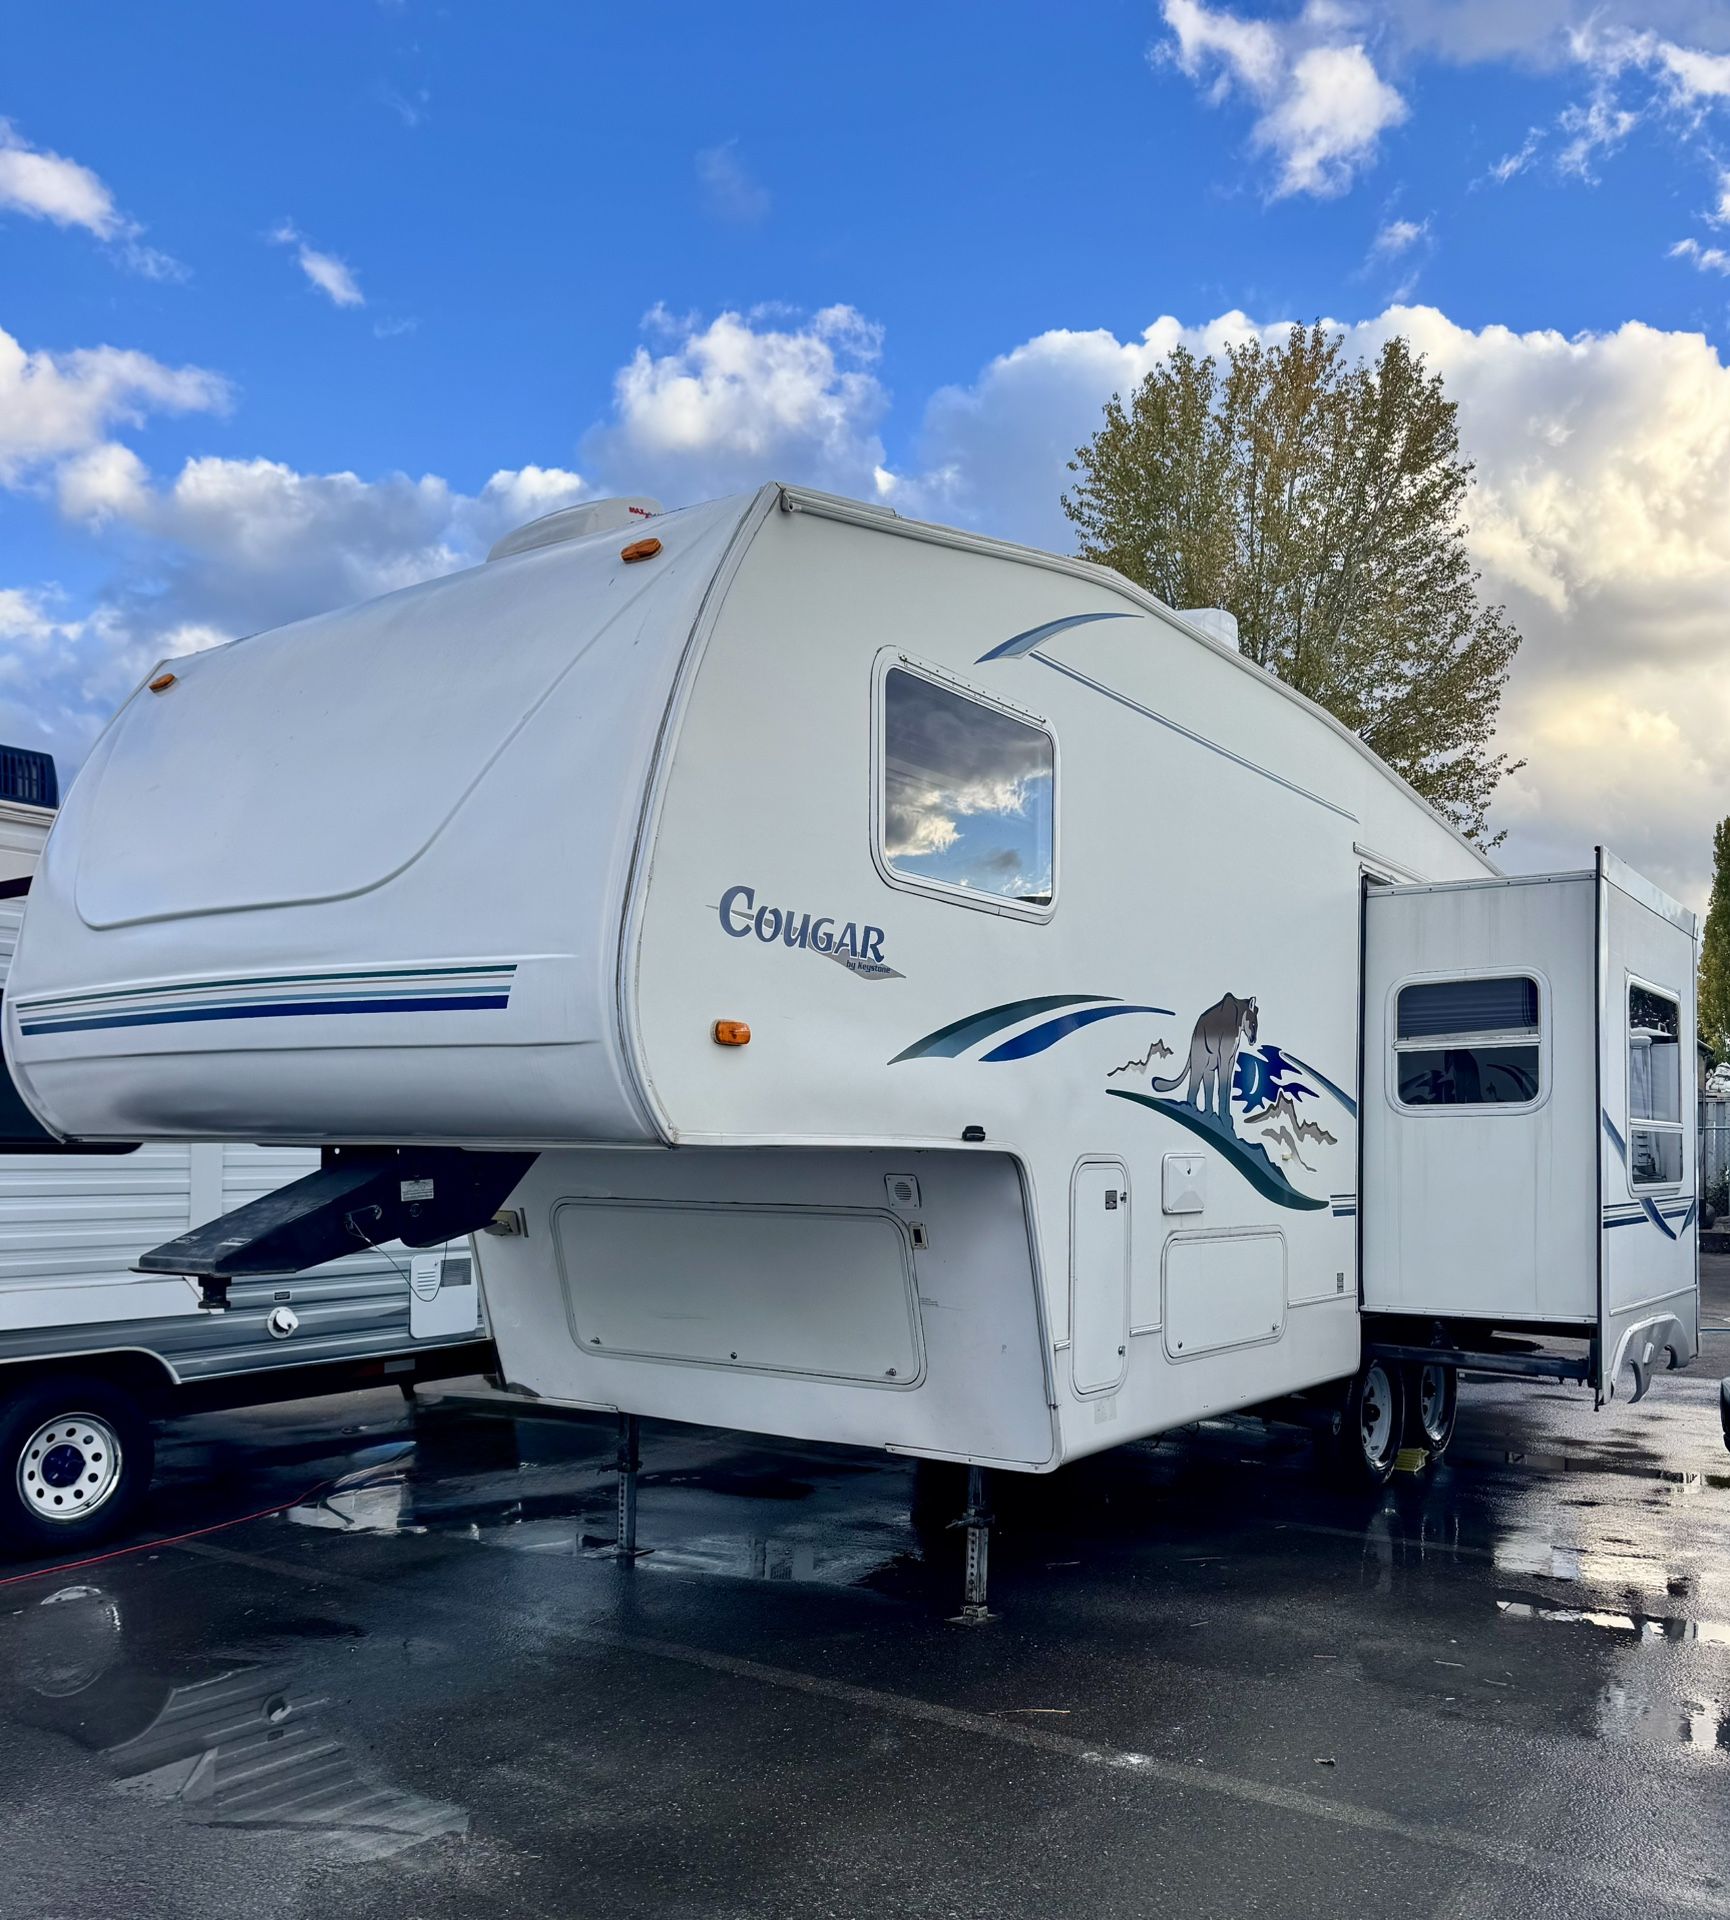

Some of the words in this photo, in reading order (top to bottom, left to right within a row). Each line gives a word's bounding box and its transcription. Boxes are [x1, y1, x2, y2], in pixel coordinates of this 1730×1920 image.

[719, 885, 885, 963] COUGAR
[846, 959, 856, 971] by
[857, 962, 891, 974] Keystone
